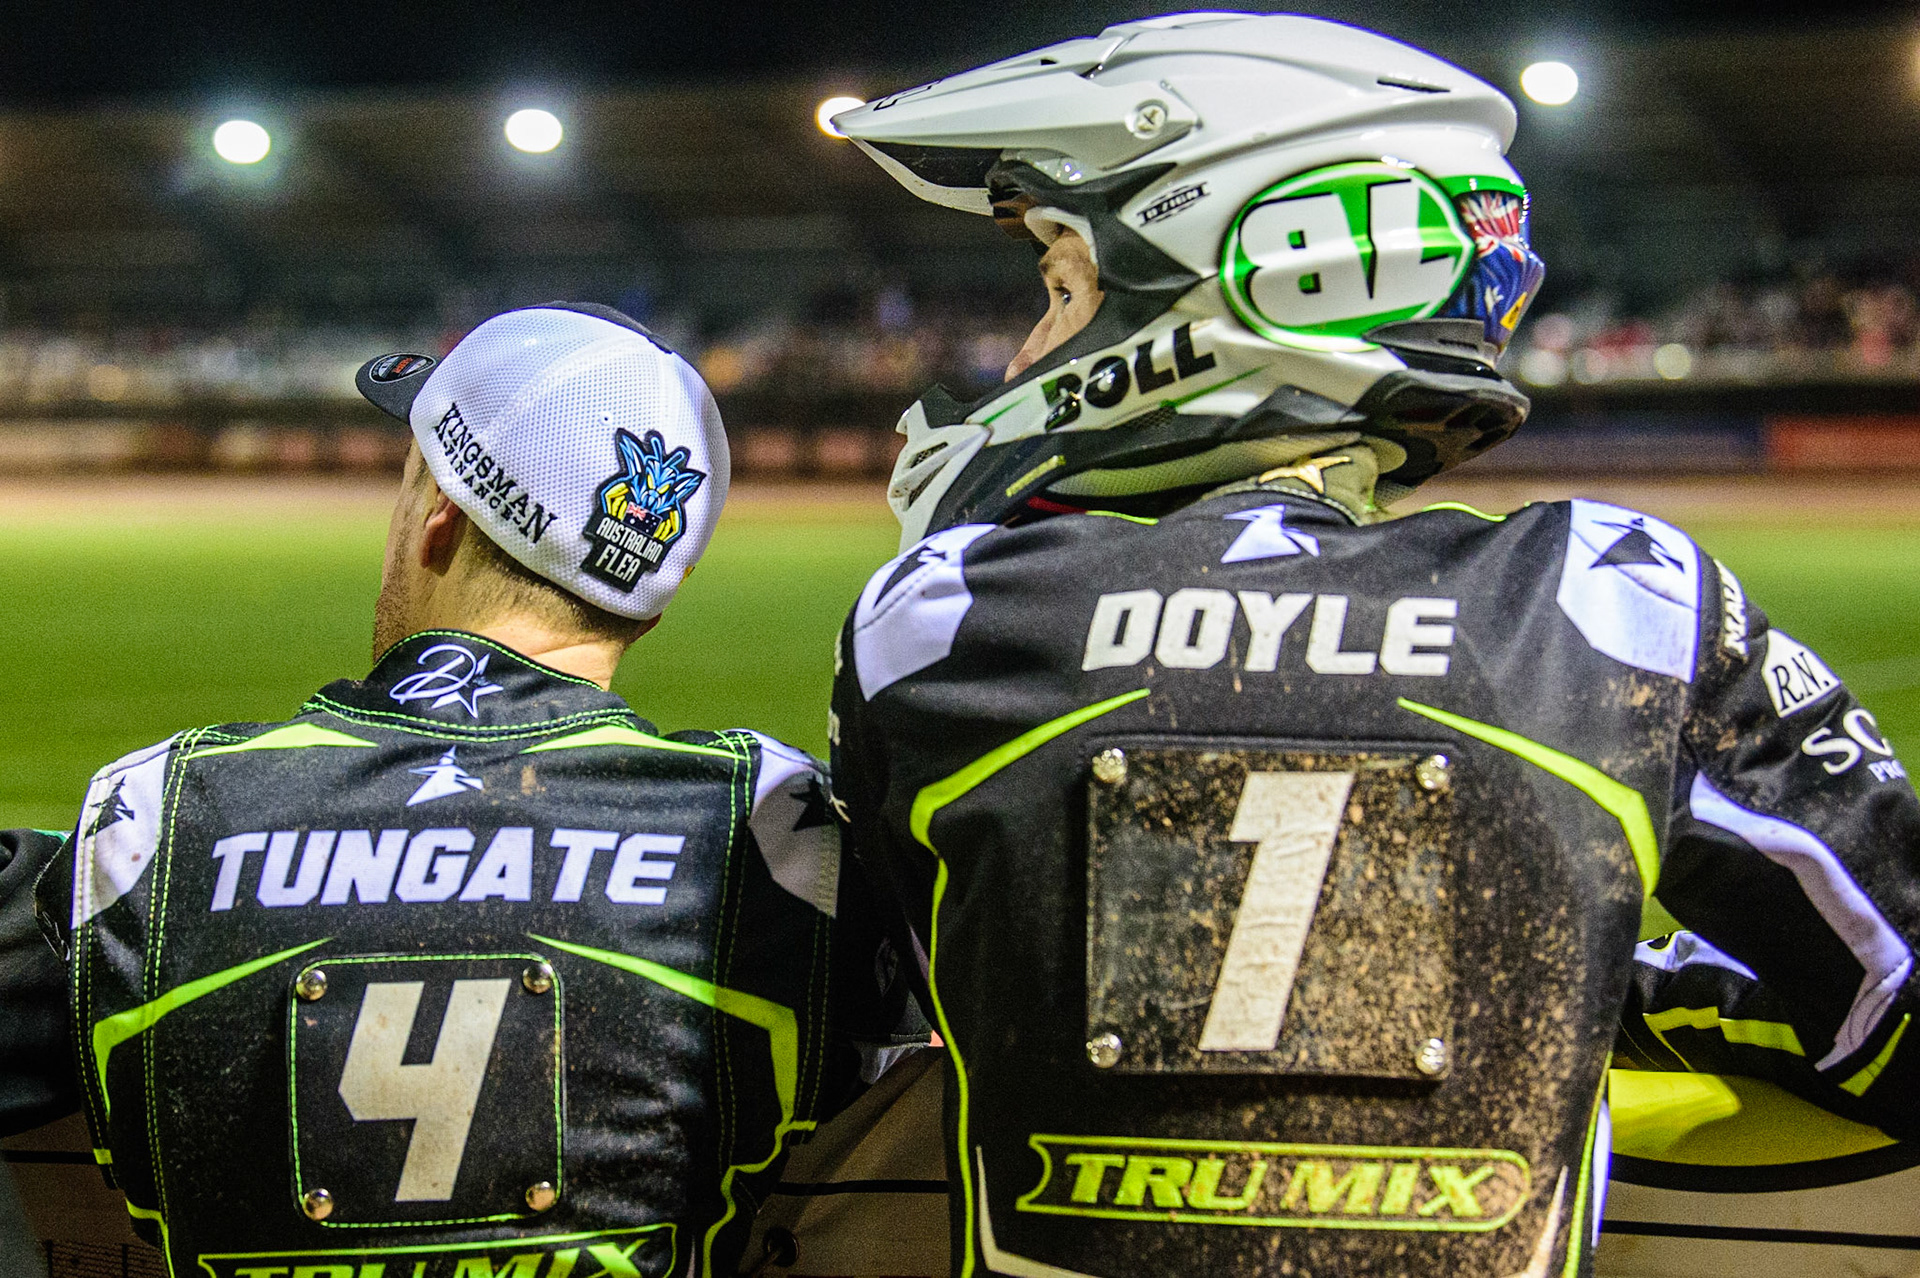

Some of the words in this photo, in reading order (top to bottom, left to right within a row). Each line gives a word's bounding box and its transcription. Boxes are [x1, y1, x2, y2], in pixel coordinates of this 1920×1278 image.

[432, 402, 559, 544] KINGSMAN
[595, 543, 641, 583] FLEA
[596, 516, 664, 564] AUSTRALIAN
[1082, 588, 1458, 676] DOYLE
[210, 826, 686, 912] TUNGATE
[1199, 771, 1355, 1051] 1
[337, 978, 512, 1202] 4
